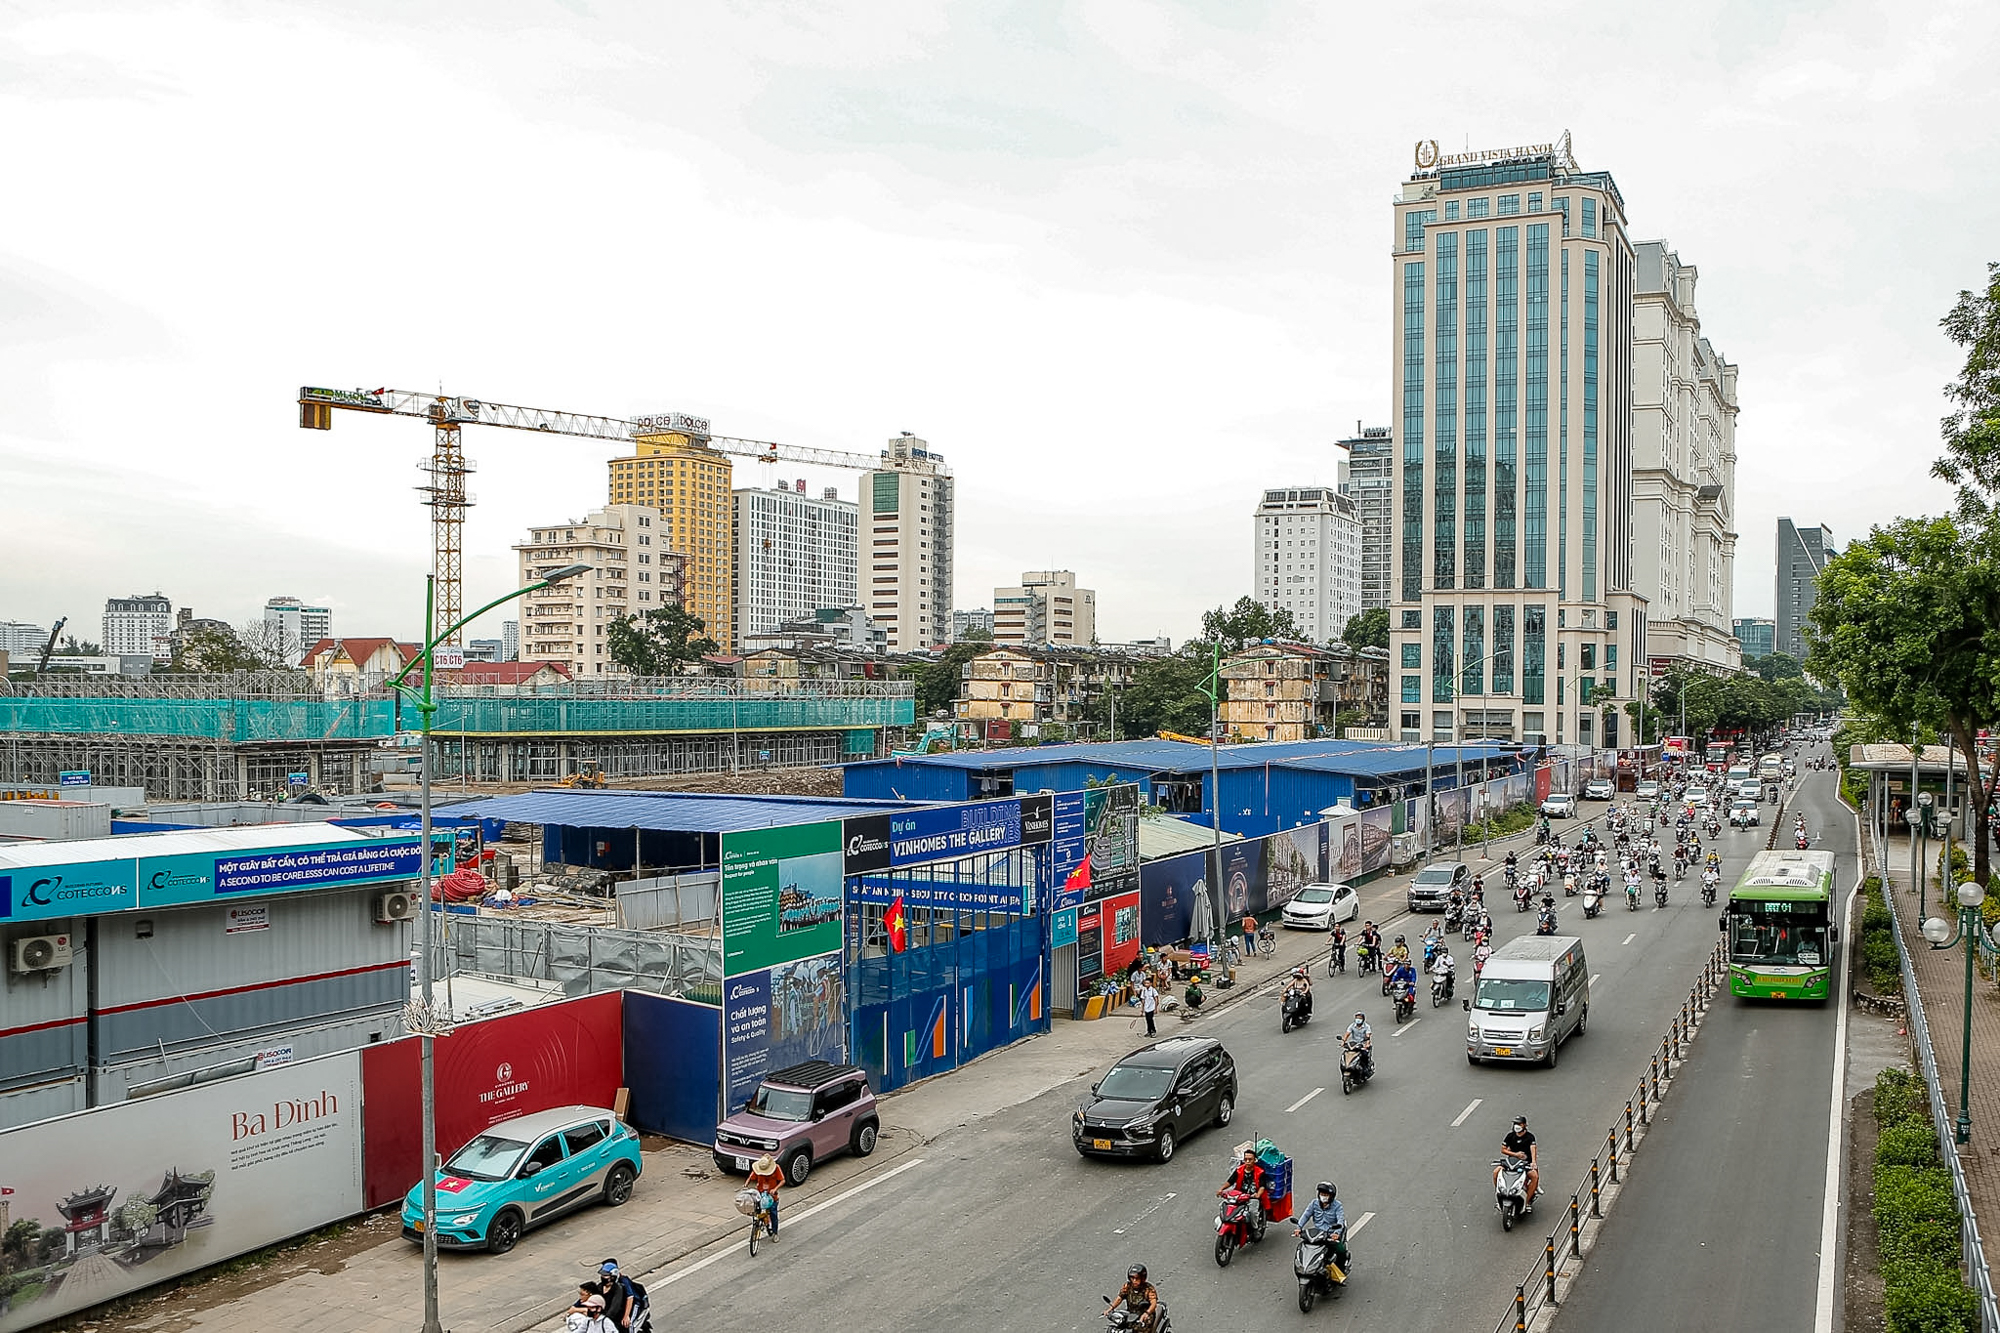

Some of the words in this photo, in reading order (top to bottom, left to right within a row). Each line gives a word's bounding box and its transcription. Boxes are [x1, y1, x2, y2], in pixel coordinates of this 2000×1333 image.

[1440, 152, 1477, 165] GRAND
[1481, 148, 1512, 160] VISTA
[1515, 143, 1553, 157] HANOI
[435, 655, 448, 665] CT6
[449, 654, 463, 665] CT6
[905, 819, 916, 831] án
[961, 803, 1021, 829] BUILDING
[1024, 820, 1049, 831] VINHOMES
[892, 835, 947, 857] VINHOMES
[949, 832, 967, 848] THE
[968, 826, 1006, 845] GALLERY
[219, 861, 238, 875] MỘT
[261, 856, 277, 869] BẤT
[297, 854, 309, 866] CÓ
[309, 851, 326, 864] THỂ
[326, 851, 342, 863] TRẢ
[342, 850, 358, 862] GIÁ
[358, 848, 379, 860] BẰNG
[379, 847, 389, 858] CẢ
[390, 846, 410, 858] CUỘC
[410, 845, 422, 855] ĐỜ
[219, 878, 226, 887] A
[226, 875, 260, 887] SECOND
[260, 874, 271, 883] TO
[272, 873, 281, 882] BE
[323, 867, 339, 877] CAN
[339, 865, 358, 875] COST
[364, 861, 395, 873] LIFETIME
[731, 1007, 748, 1020] Chất
[748, 1005, 766, 1017] lượng
[731, 1022, 740, 1033] và
[741, 1022, 750, 1031] an
[751, 1017, 767, 1028] toàn
[479, 1091, 495, 1103] THE
[496, 1082, 528, 1098] GALLERY
[231, 1111, 266, 1142] Ba
